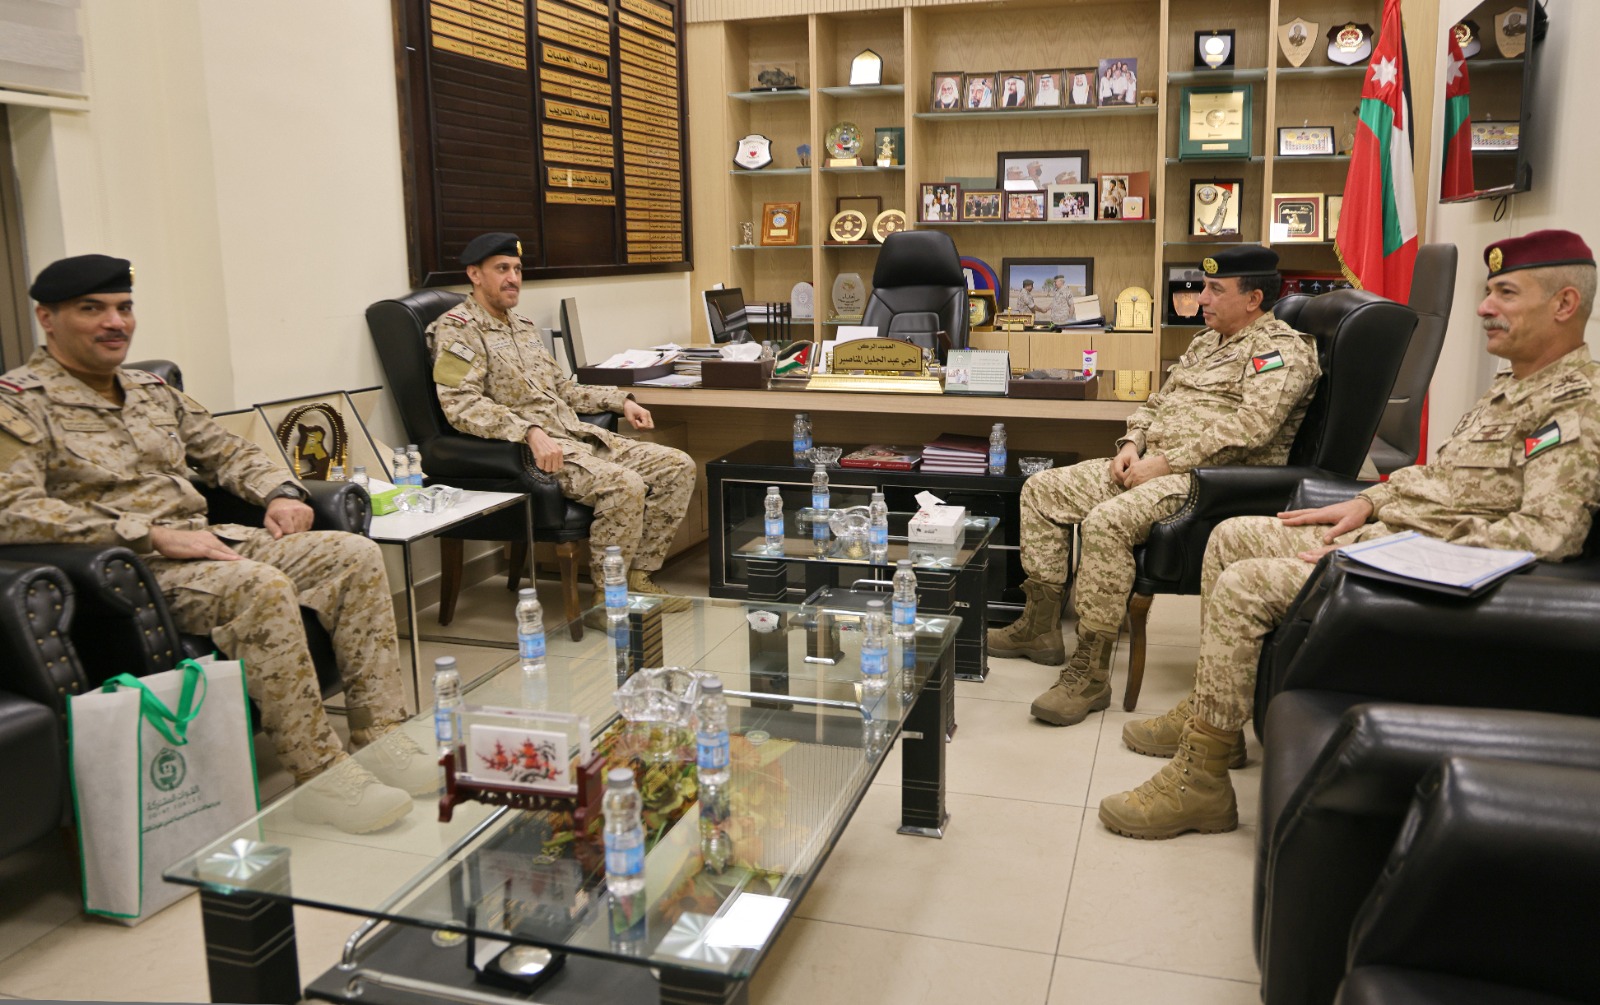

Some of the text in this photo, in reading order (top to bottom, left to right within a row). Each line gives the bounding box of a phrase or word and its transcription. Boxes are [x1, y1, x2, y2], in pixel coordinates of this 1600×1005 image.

[589, 62, 604, 73] رؤساء
[591, 113, 607, 124] رؤساء
[839, 355, 863, 364] المناصير
[864, 355, 886, 365] الجليل
[901, 357, 917, 367] نجي
